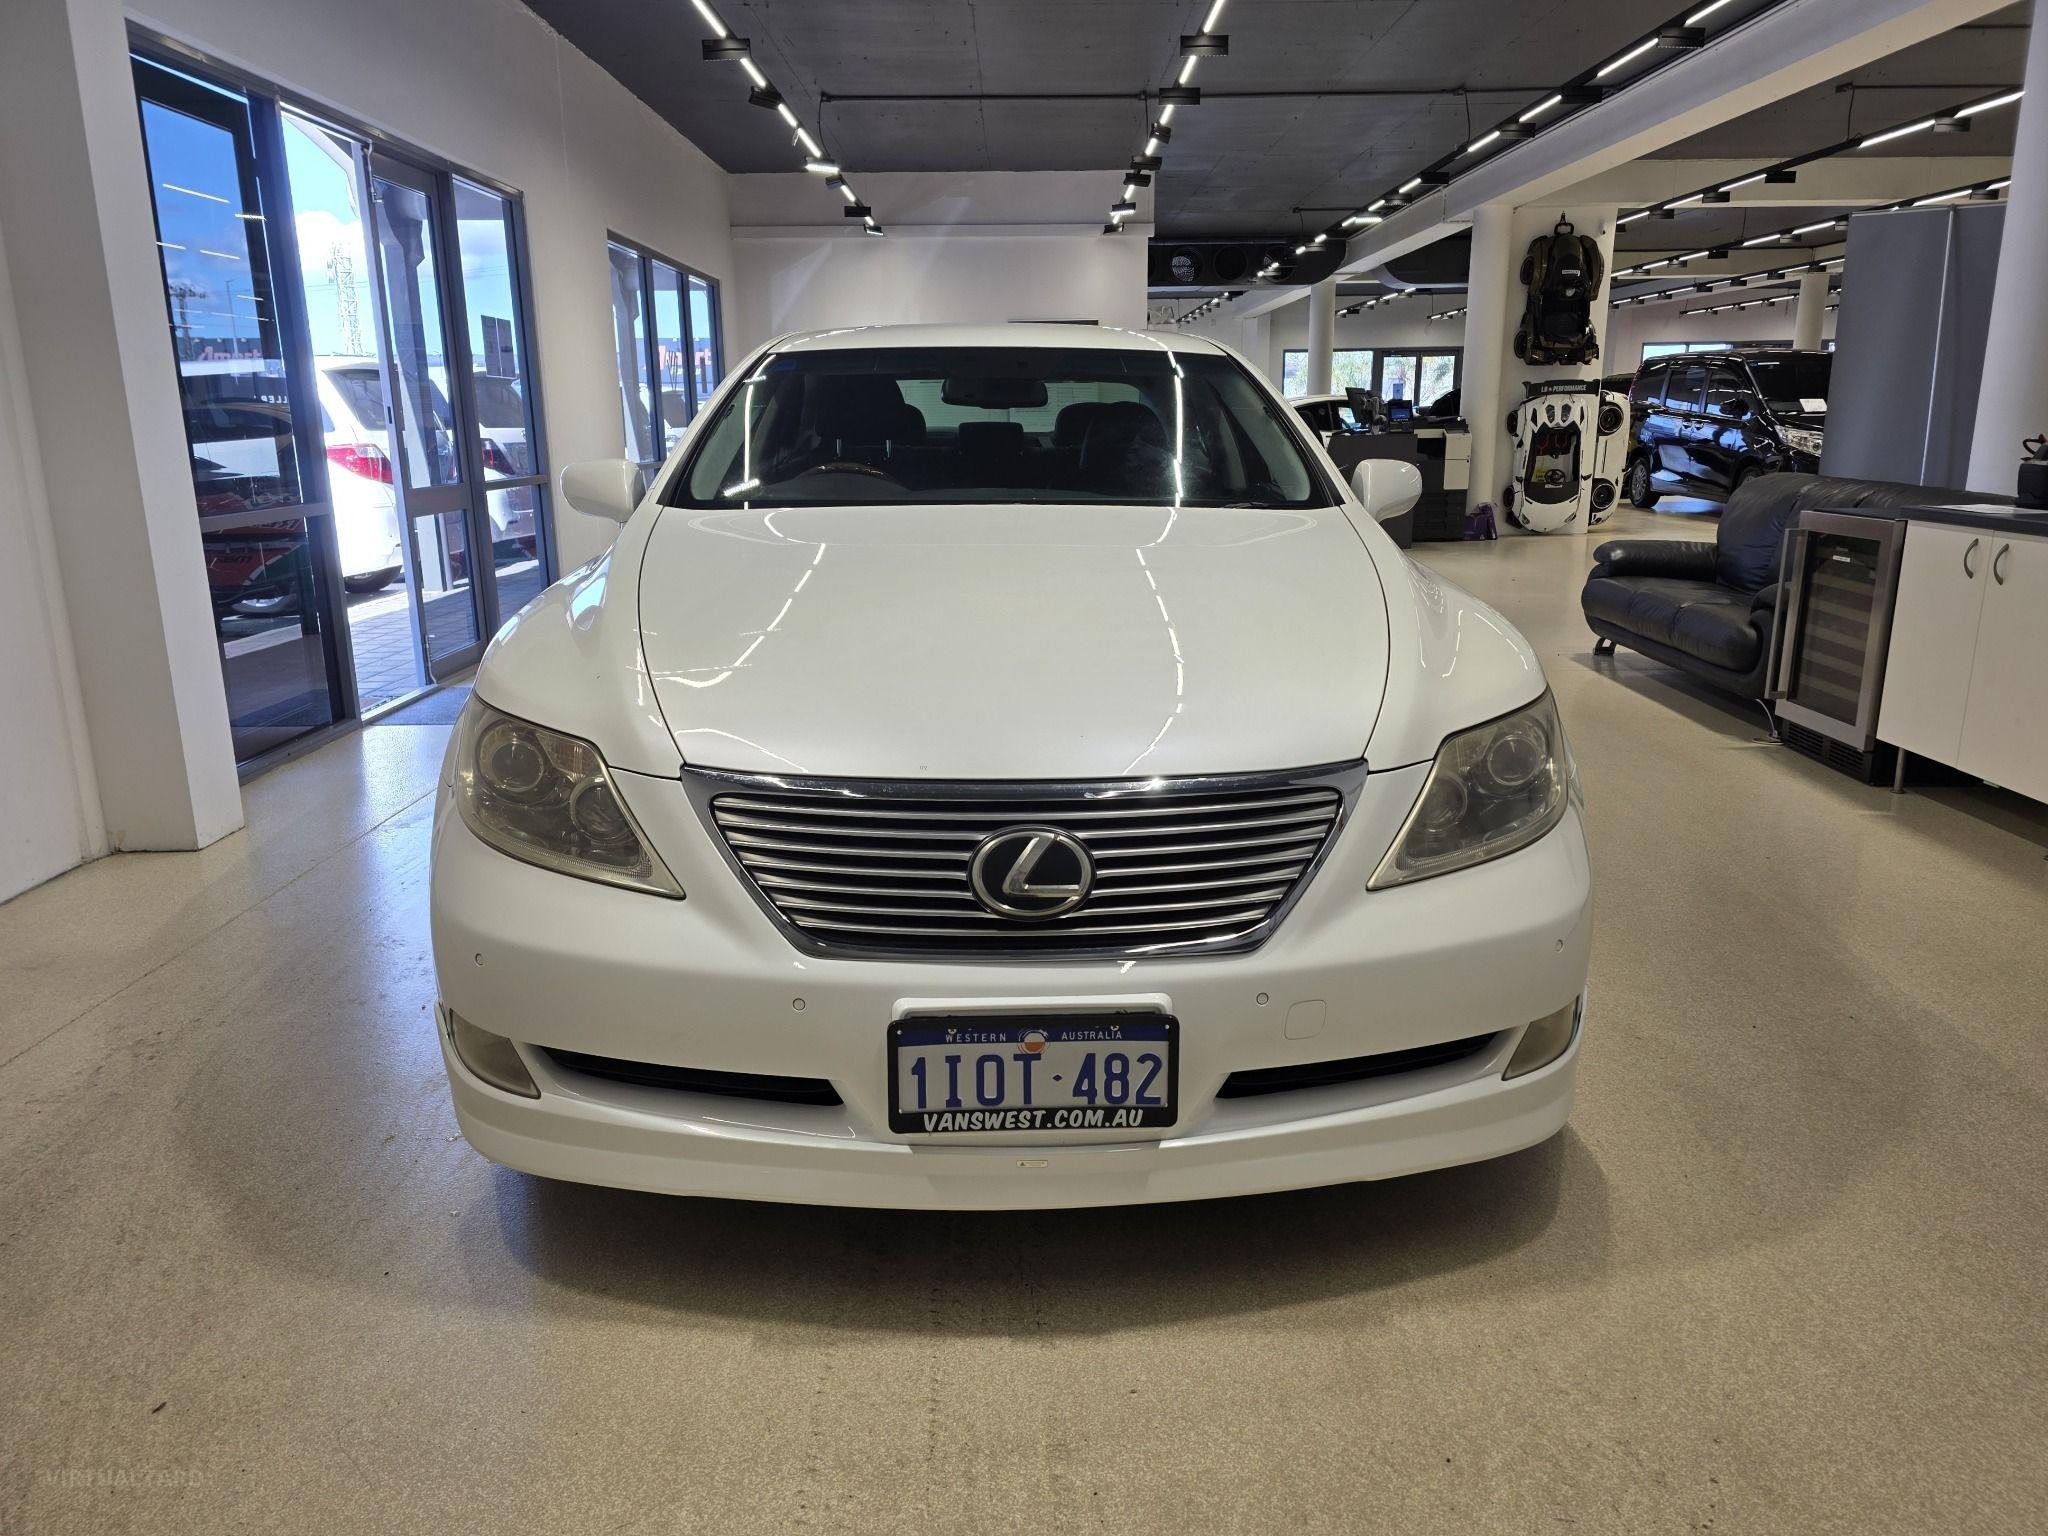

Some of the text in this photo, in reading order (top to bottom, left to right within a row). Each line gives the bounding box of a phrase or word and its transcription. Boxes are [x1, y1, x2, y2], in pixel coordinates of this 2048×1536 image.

[1552, 384, 1587, 392] PERFORMANCE
[945, 1030, 1123, 1043] WESTERN AUSTRALIA
[1072, 1053, 1163, 1105] 482
[923, 1109, 1143, 1132] VANSWEST.COM.AU
